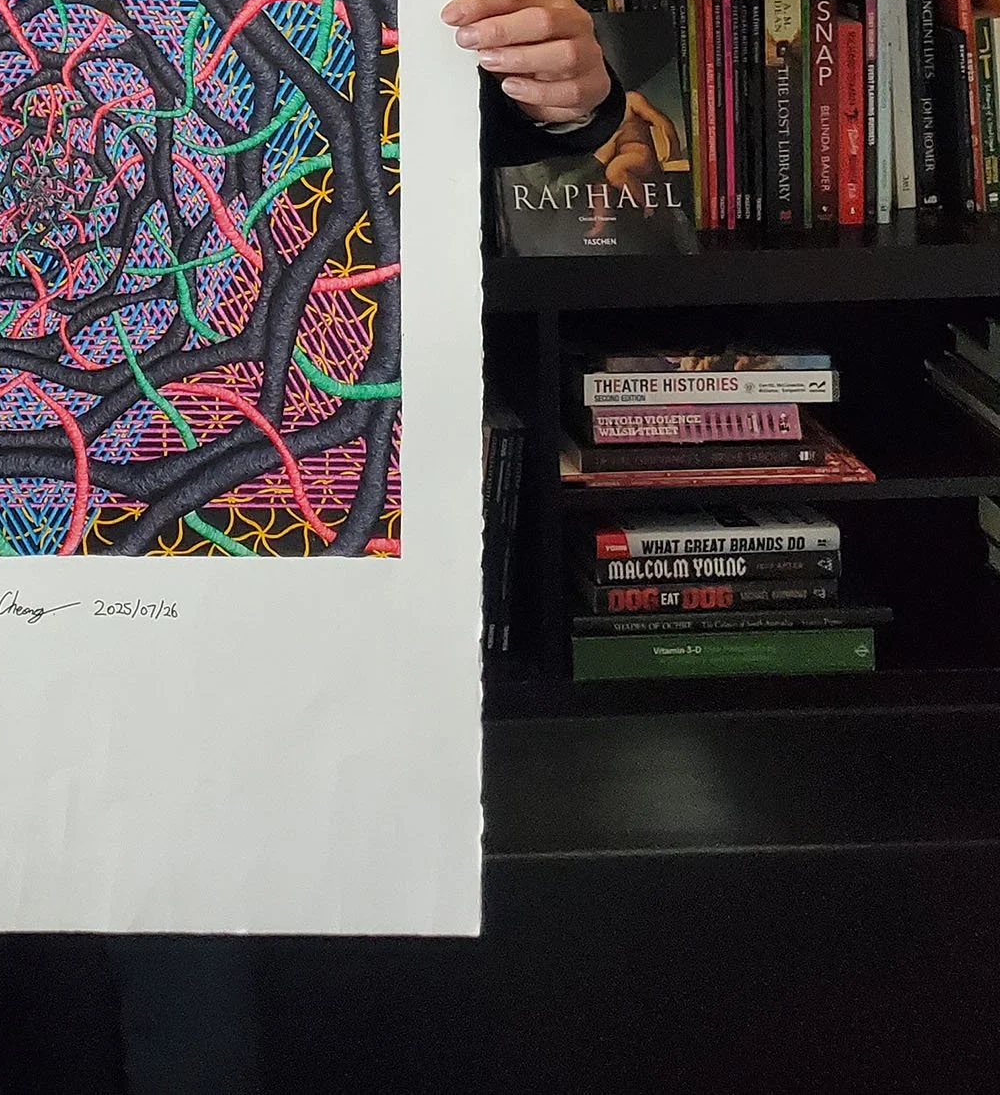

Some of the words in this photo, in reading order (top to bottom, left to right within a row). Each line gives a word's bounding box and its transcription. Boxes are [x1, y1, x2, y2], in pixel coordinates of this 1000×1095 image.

[815, 1, 834, 86] SNAP
[924, 47, 936, 79] LIVES
[777, 66, 789, 96] THE
[778, 100, 789, 136] LOST
[778, 143, 790, 202] LIBRARY
[513, 181, 683, 211] RAPHAEL
[584, 238, 617, 246] TASCHEN
[594, 379, 658, 394] THEATRE
[663, 377, 738, 393] HISTORIES
[621, 394, 646, 402] EDITION
[597, 416, 644, 427] UNTOLD
[646, 414, 701, 425] VIOLENCE
[641, 540, 681, 554] WHAT
[684, 539, 727, 553] GREAT
[730, 537, 784, 552] BRANDS
[788, 536, 805, 550] DO
[608, 560, 690, 581] MALCOLM
[693, 557, 747, 577] YOUNG
[94, 599, 178, 620] 2025/07/26
[608, 587, 659, 611] DOG
[661, 592, 680, 605] EAT
[683, 585, 733, 609] DOG
[653, 646, 685, 655] Vitamin
[686, 646, 702, 654] 3-D
